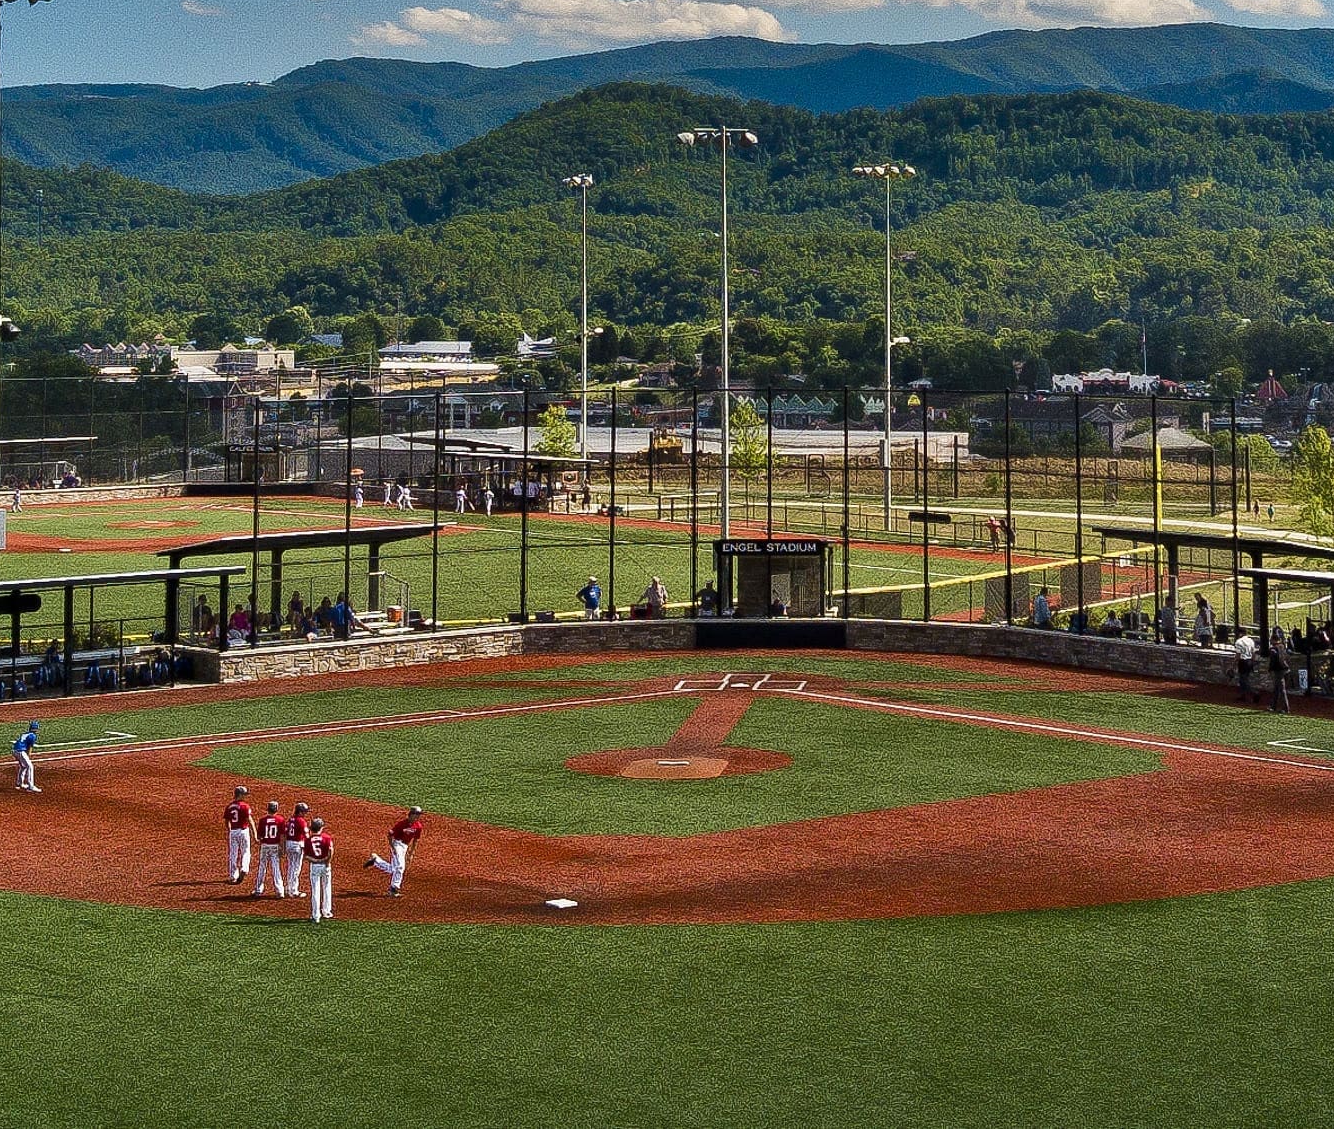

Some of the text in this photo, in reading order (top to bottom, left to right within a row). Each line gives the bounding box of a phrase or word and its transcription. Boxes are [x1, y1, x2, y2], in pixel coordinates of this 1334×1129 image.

[722, 542, 817, 552] ENGEL STADIUM
[230, 810, 239, 823] 3
[264, 825, 277, 839] 10
